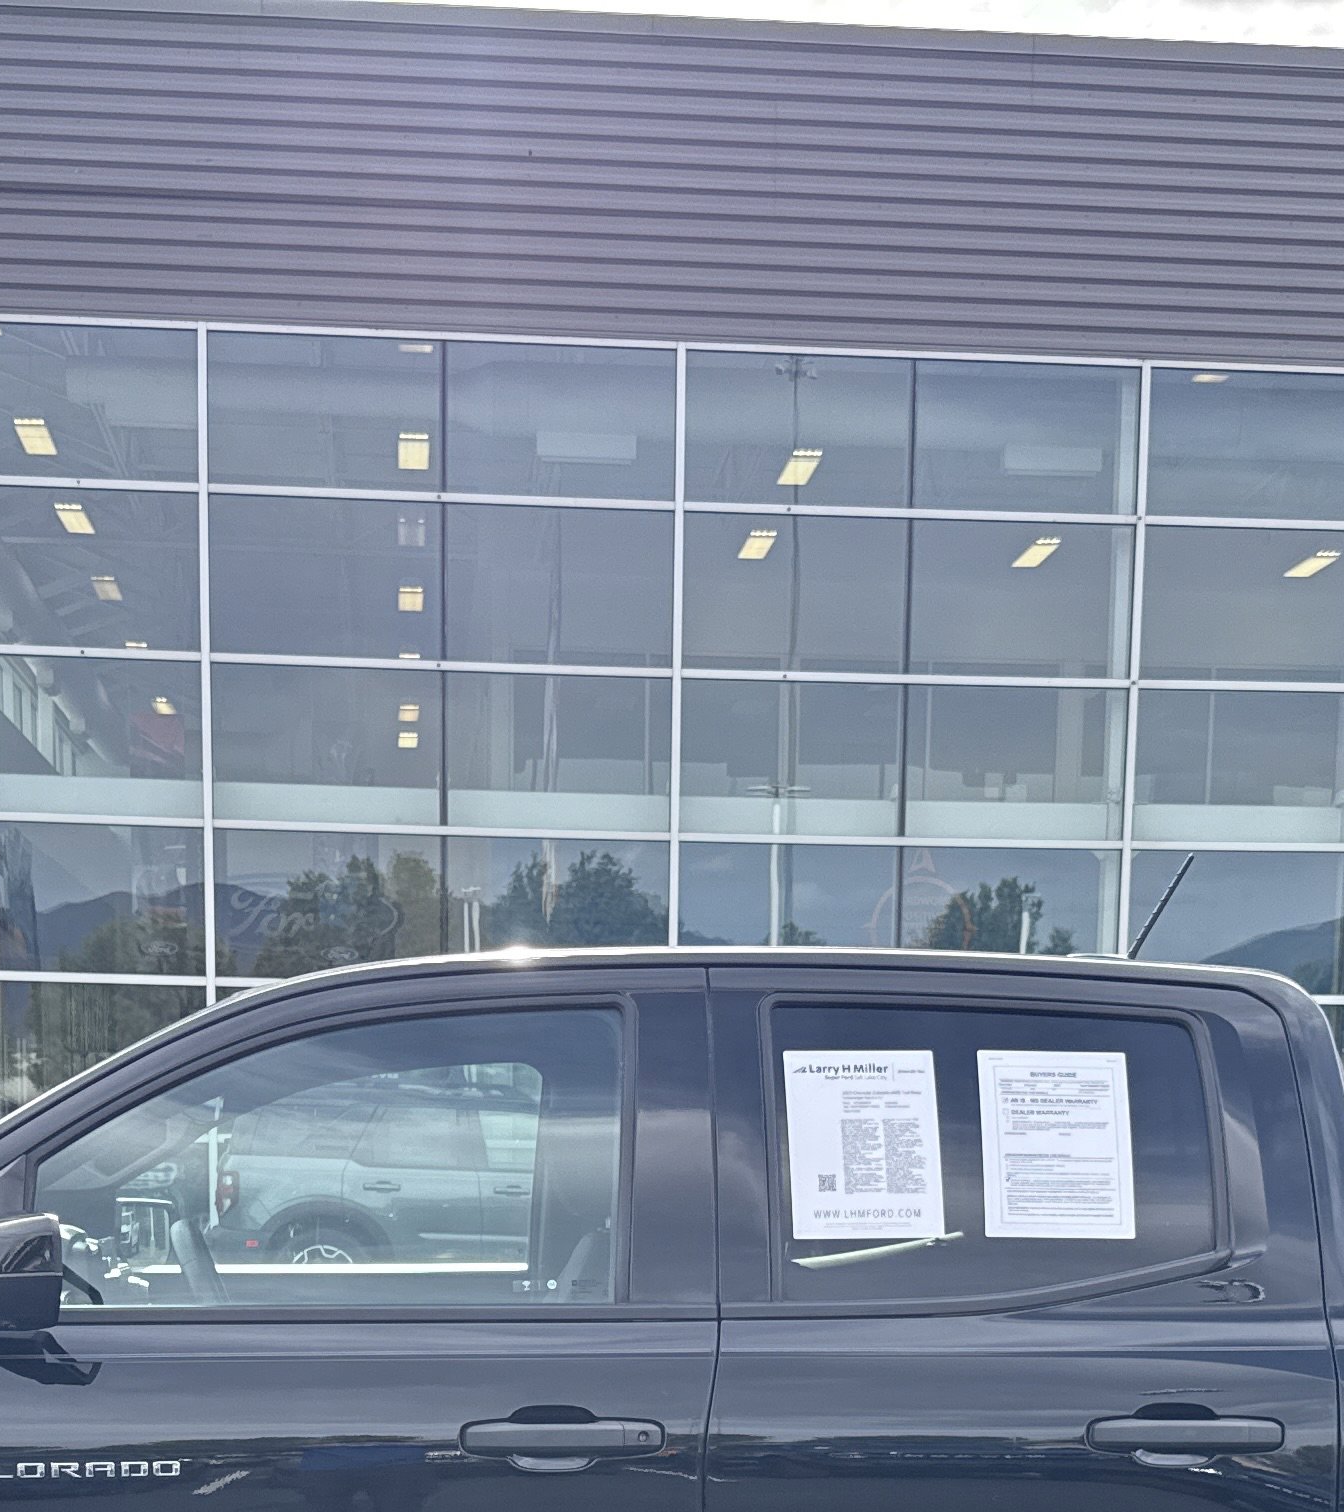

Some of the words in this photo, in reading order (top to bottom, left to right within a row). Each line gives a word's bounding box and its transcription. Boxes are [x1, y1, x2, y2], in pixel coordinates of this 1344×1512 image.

[808, 1064, 840, 1075] Larry
[842, 1065, 851, 1073] H
[853, 1063, 889, 1073] Miller
